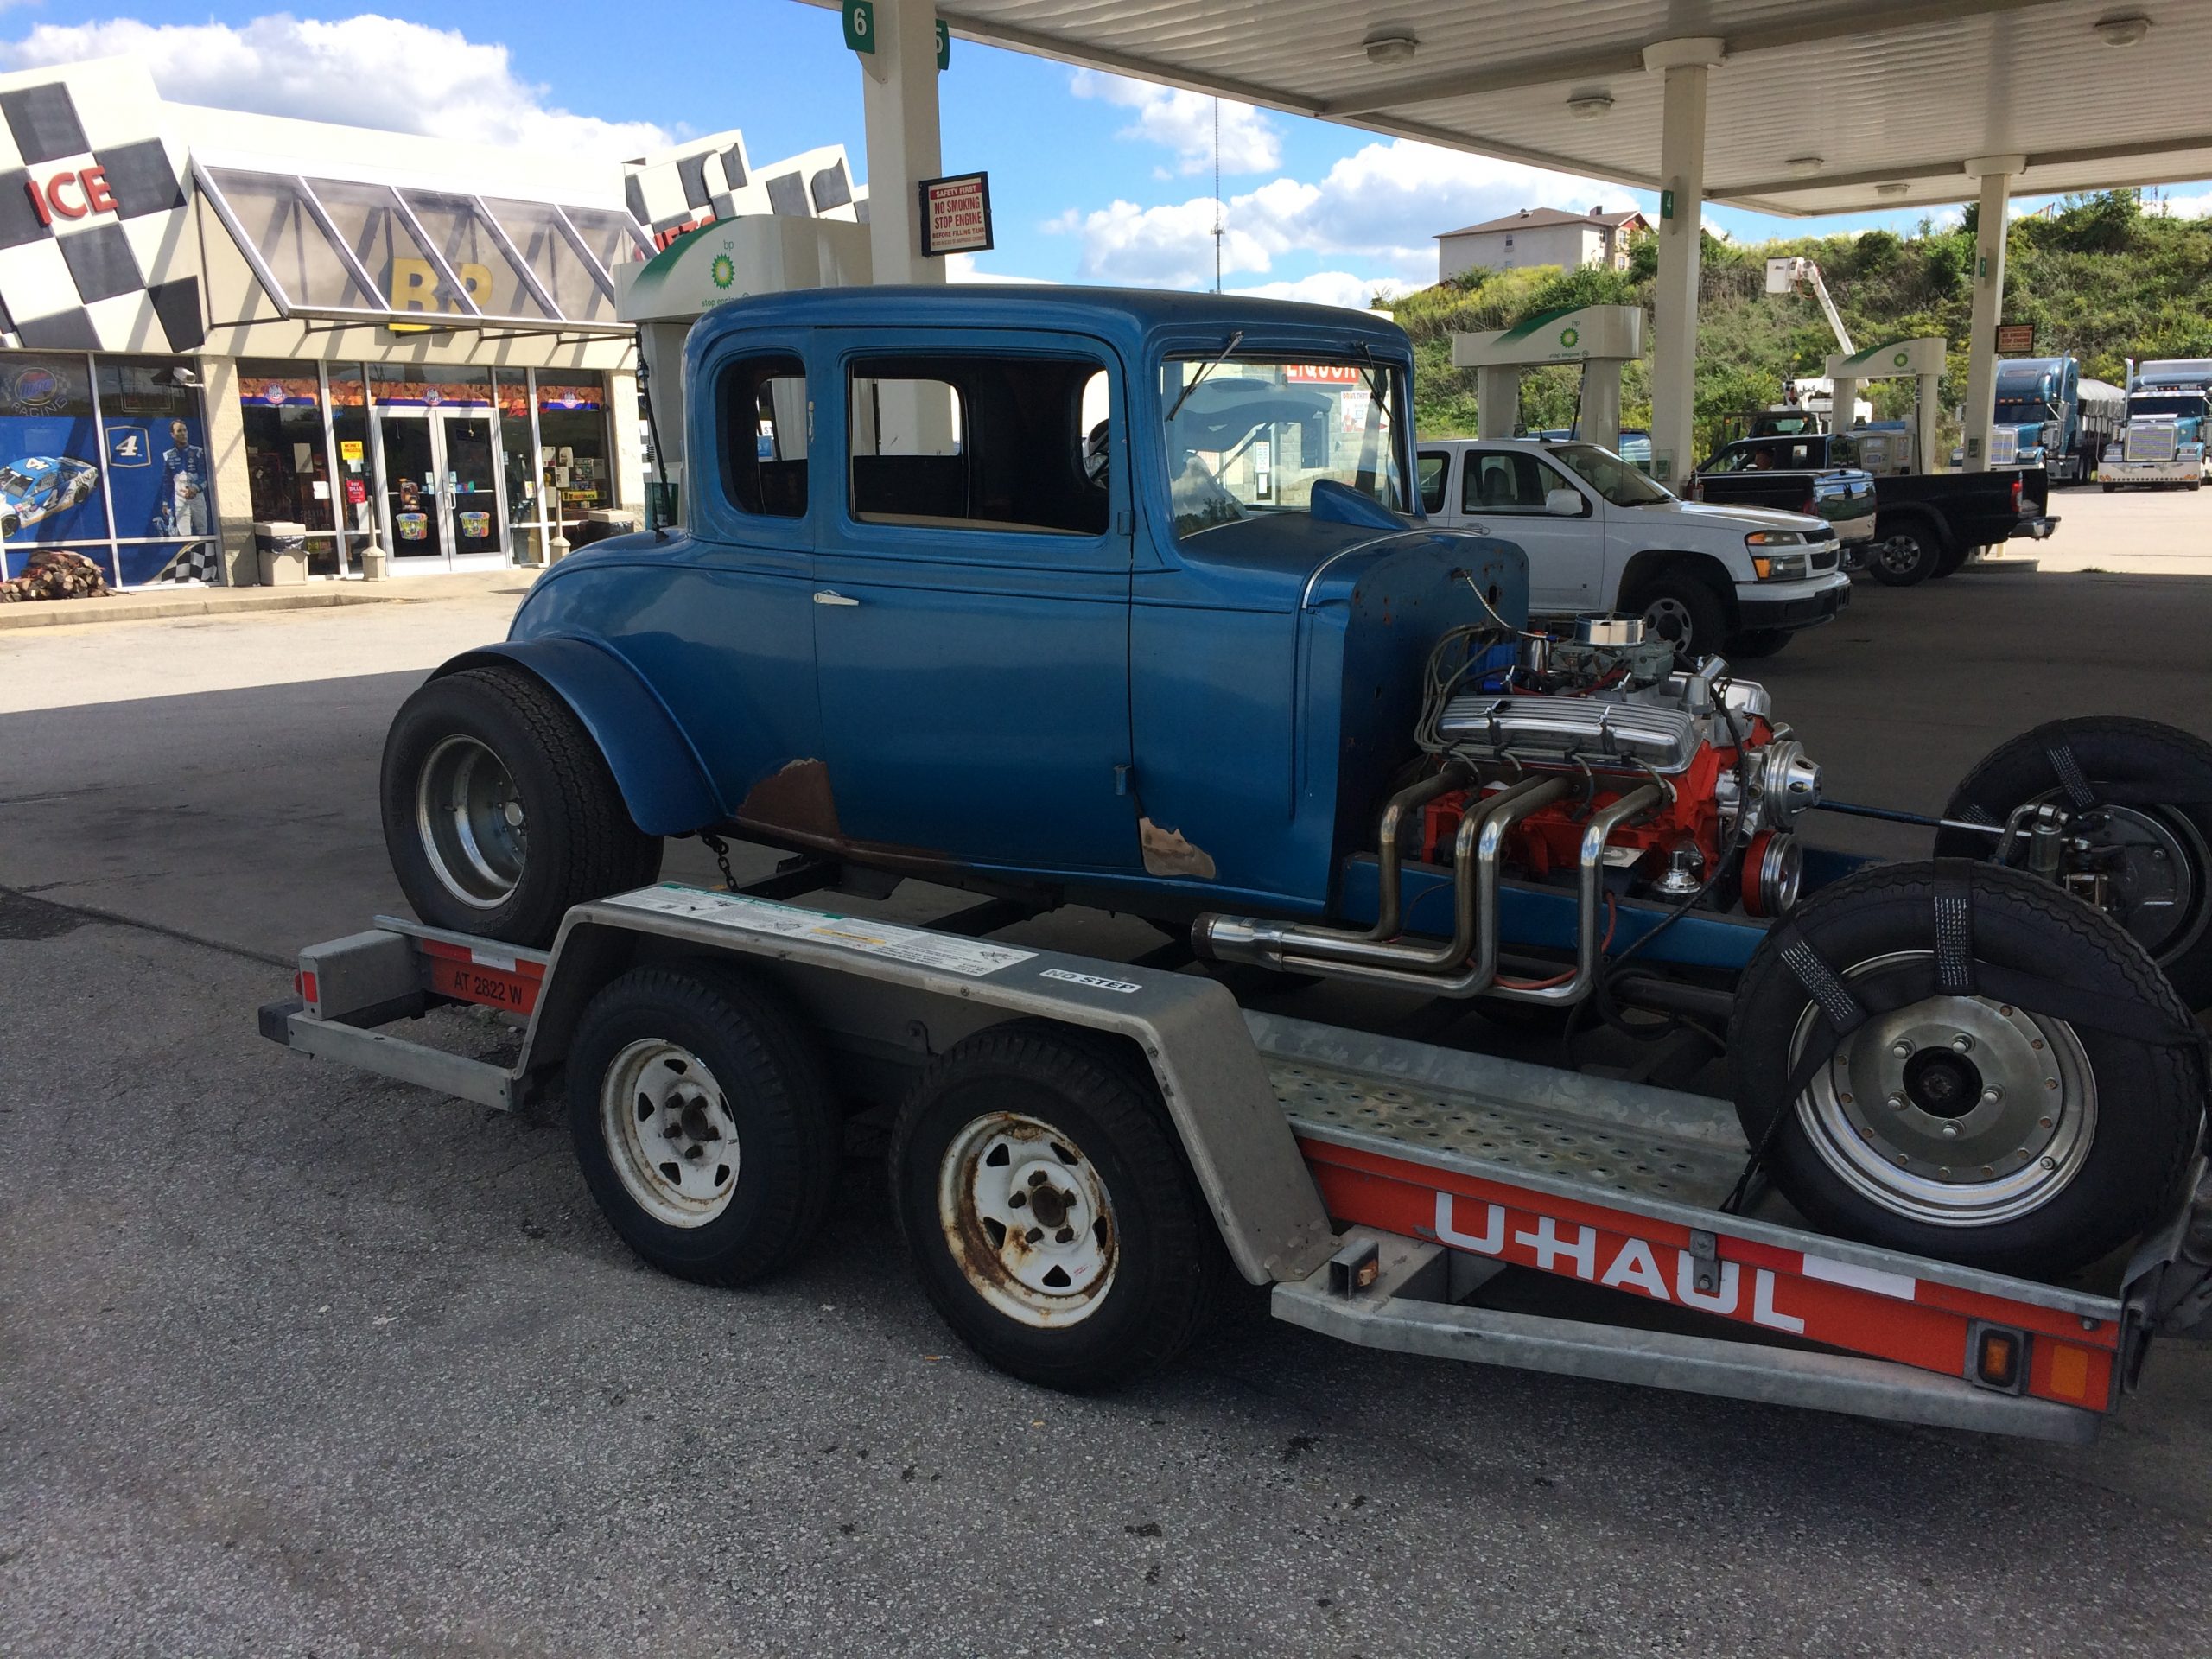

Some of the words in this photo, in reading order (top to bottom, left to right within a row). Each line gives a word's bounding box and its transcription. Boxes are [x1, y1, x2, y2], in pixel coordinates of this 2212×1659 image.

[854, 7, 867, 35] 6
[25, 165, 119, 226] ICE
[936, 188, 958, 198] SAFETY
[959, 185, 977, 194] FIRST
[934, 200, 945, 214] NO
[947, 196, 981, 213] SMOKING
[1666, 195, 1672, 210] 4
[934, 215, 953, 230] STOP
[955, 212, 982, 226] ENGINE
[952, 228, 971, 237] FILLING
[723, 239, 734, 251] bp
[389, 258, 493, 331] BP
[702, 299, 715, 308] stop
[11, 395, 68, 418] RACING
[115, 435, 137, 457] 4
[25, 458, 51, 471] 4
[454, 971, 470, 992] AT
[474, 976, 506, 1001] 2822
[509, 985, 522, 1005] W
[1045, 969, 1078, 980] NO
[1079, 977, 1135, 989] STEP
[1435, 1192, 1805, 1334] U-HAUL
